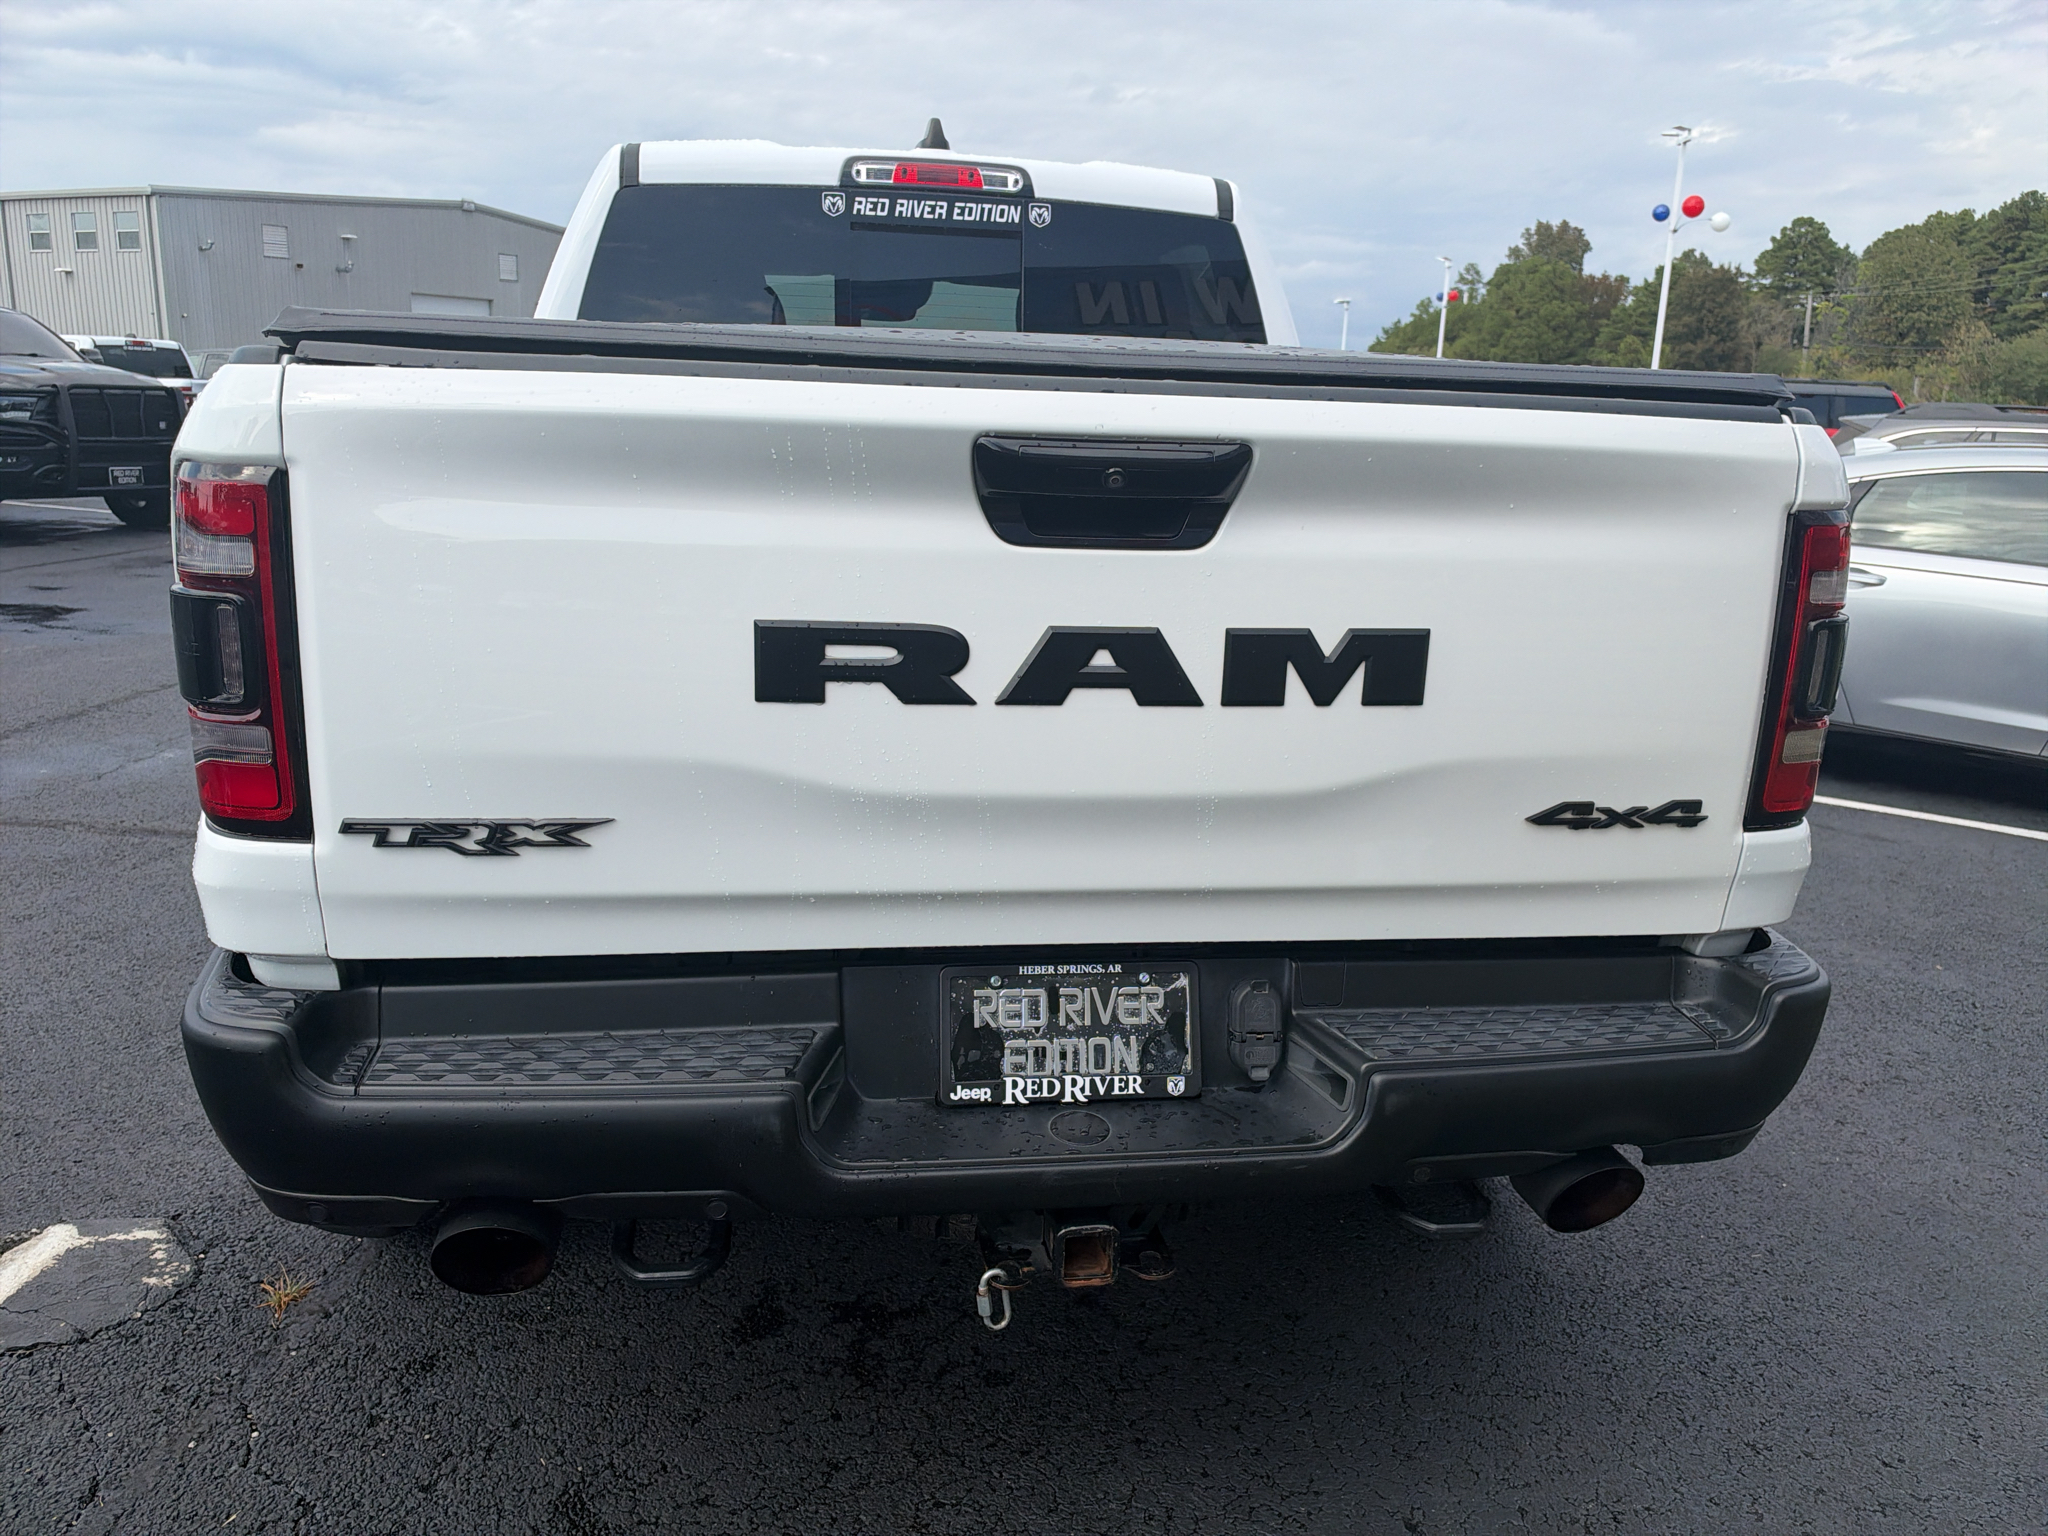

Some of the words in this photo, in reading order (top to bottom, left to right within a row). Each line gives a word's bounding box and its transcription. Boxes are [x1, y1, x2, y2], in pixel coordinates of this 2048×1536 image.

[853, 197, 889, 216] RED
[895, 199, 947, 219] RIVER
[953, 202, 1021, 223] EDITION
[754, 619, 1431, 706] RAM
[1525, 799, 1708, 830] 4x4
[338, 818, 615, 856] TRX
[1018, 965, 1055, 975] HEBER
[1057, 964, 1105, 974] SPRINGS,
[1106, 964, 1122, 973] AR
[973, 988, 1048, 1029] RED
[1059, 986, 1165, 1026] RIVER
[1003, 1035, 1140, 1076] EDITION
[950, 1085, 992, 1102] Jeep
